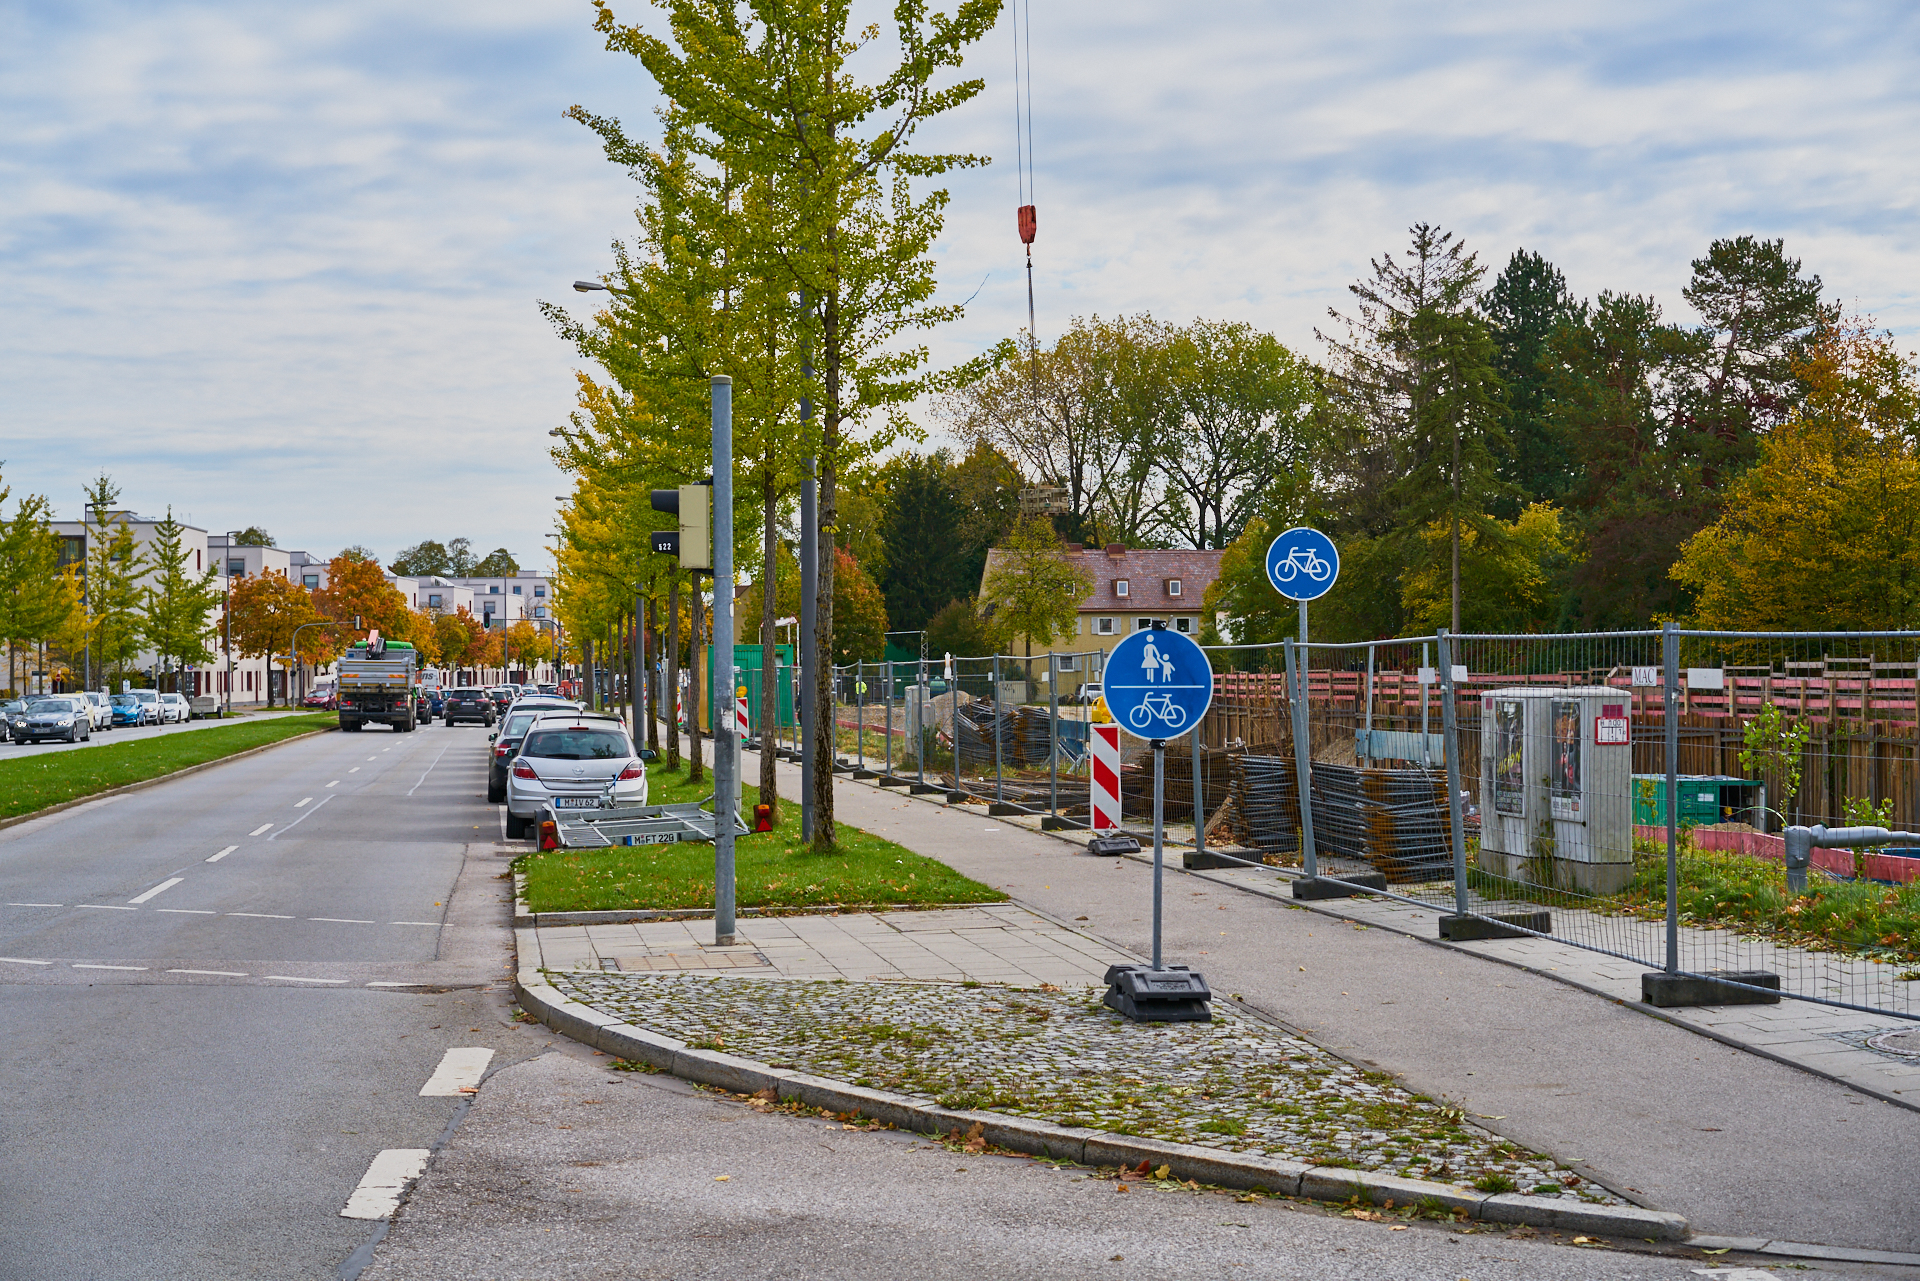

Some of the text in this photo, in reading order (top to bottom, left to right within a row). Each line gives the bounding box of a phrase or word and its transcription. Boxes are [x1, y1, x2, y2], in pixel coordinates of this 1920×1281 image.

[658, 542, 672, 551] 522
[1634, 667, 1655, 683] MAC
[564, 799, 594, 807] M IV 62
[634, 836, 641, 844] M
[645, 834, 656, 844] FT
